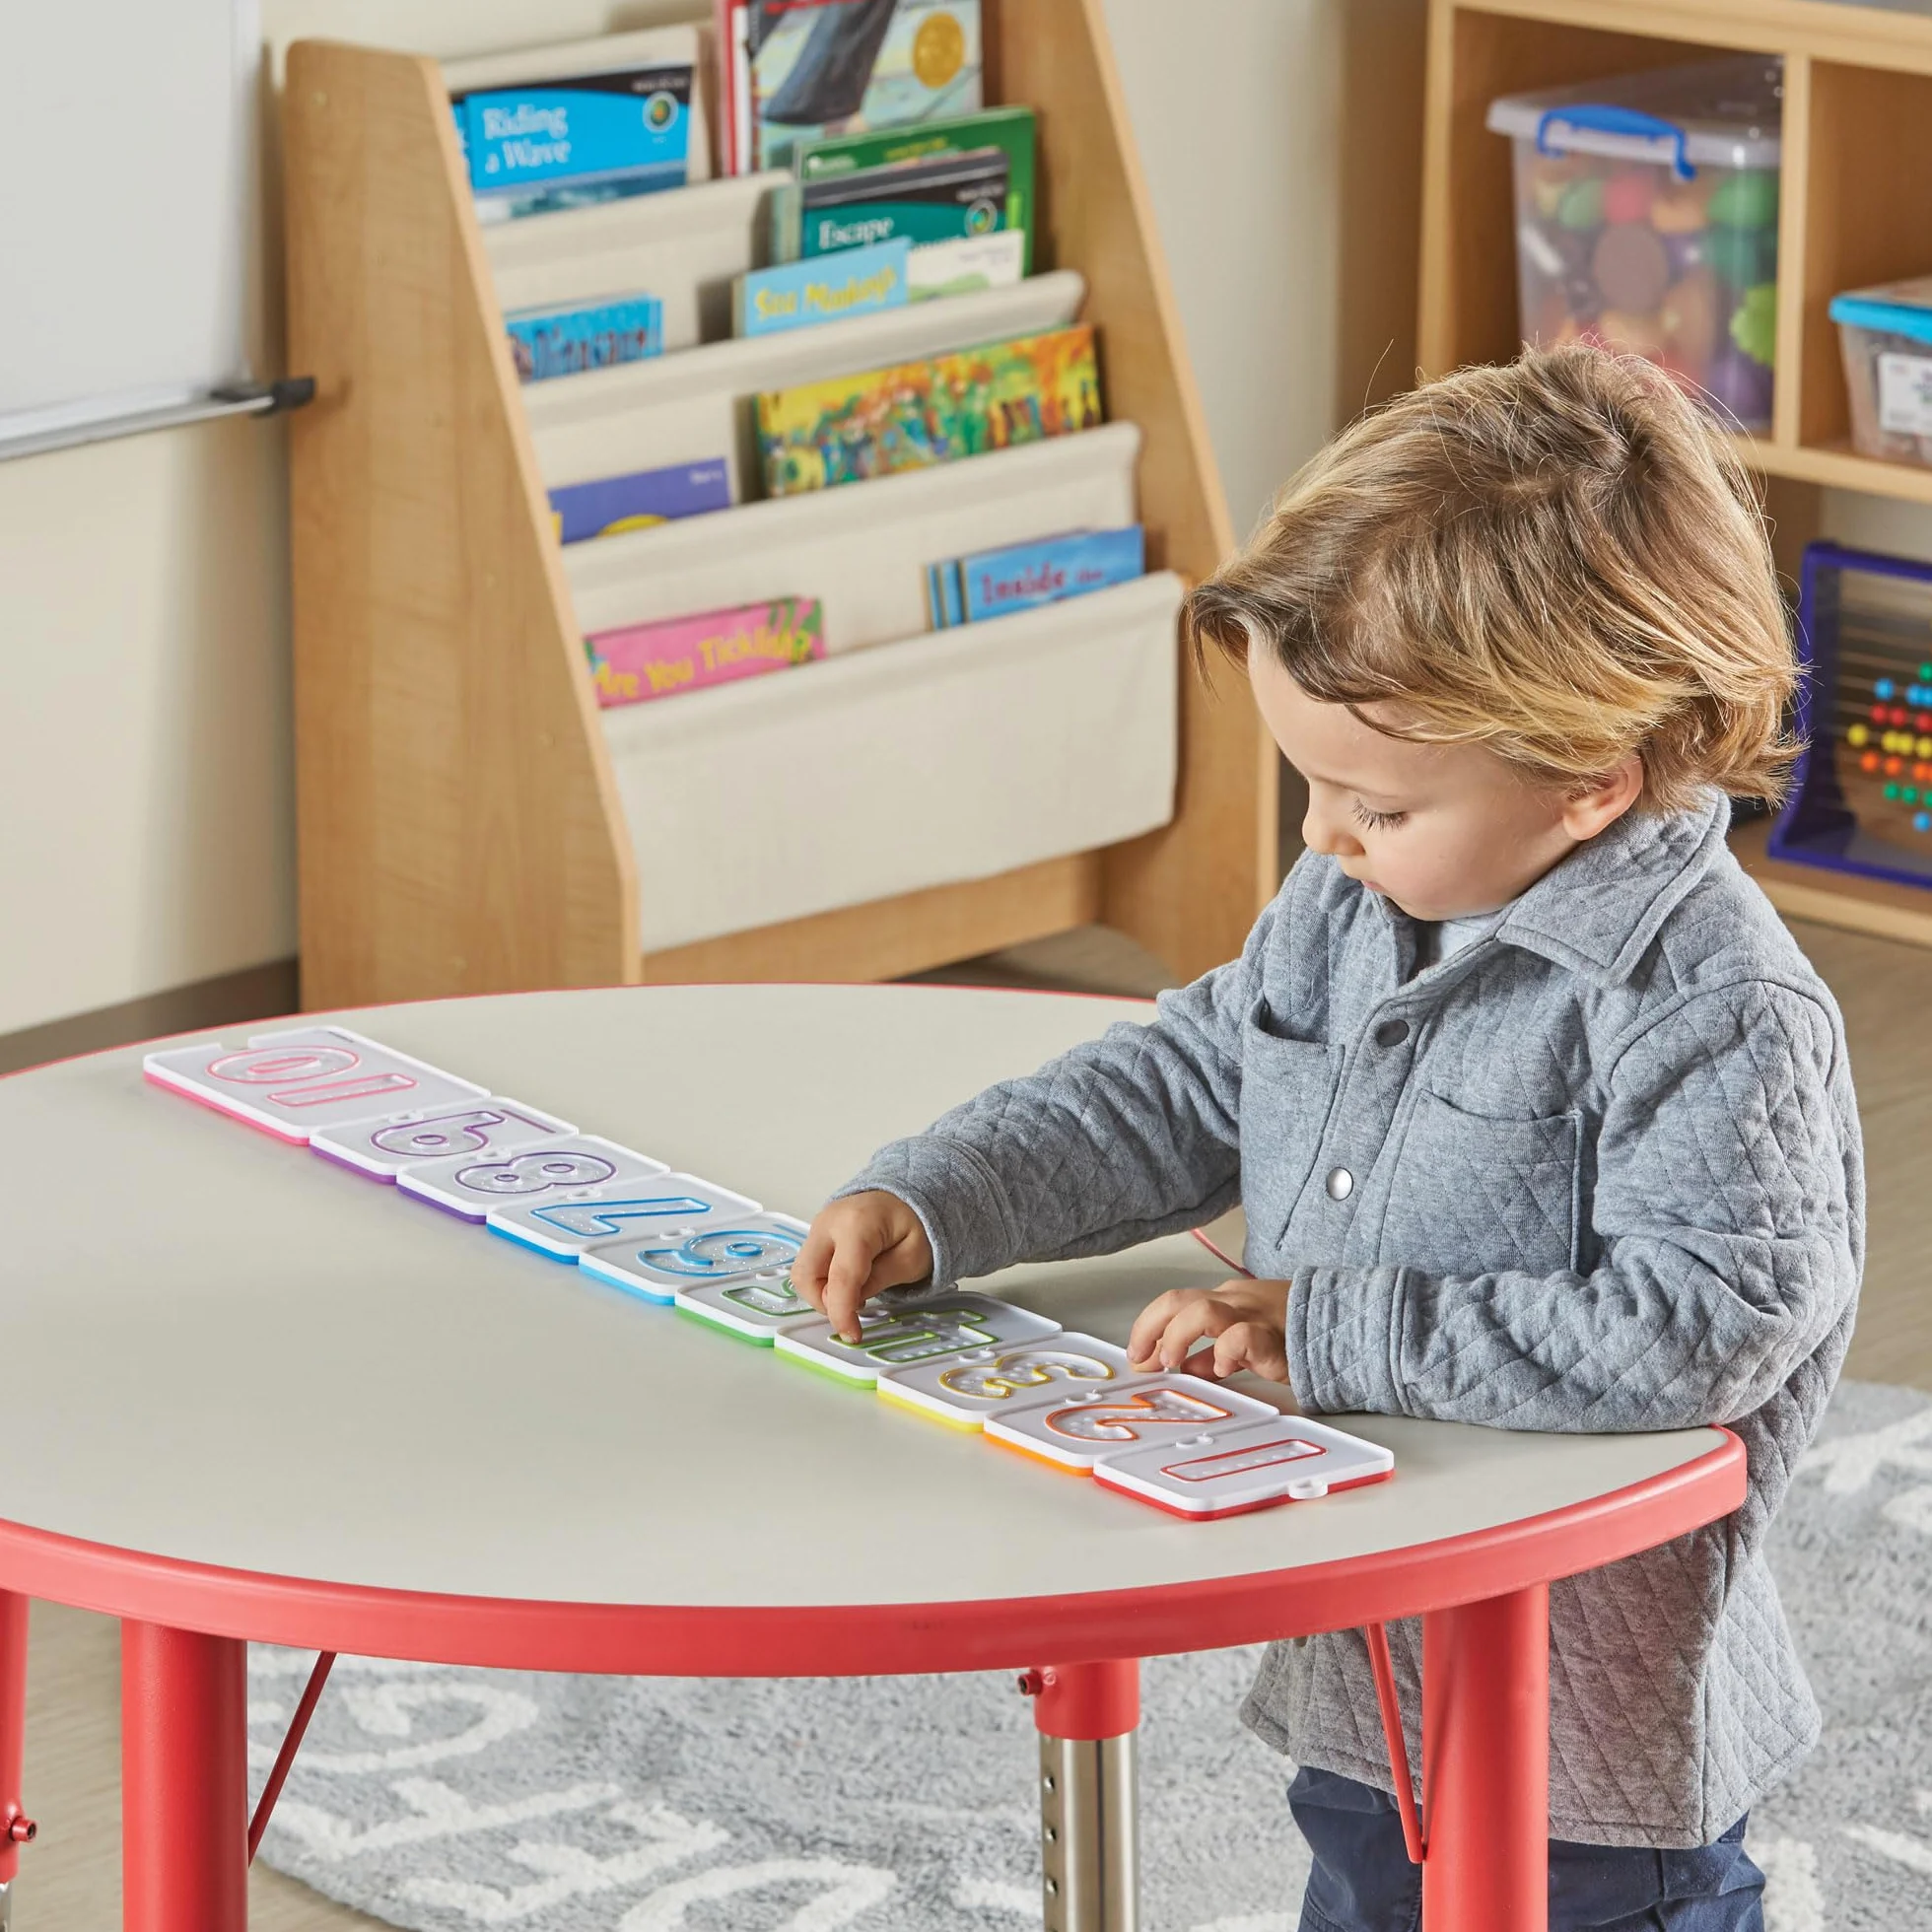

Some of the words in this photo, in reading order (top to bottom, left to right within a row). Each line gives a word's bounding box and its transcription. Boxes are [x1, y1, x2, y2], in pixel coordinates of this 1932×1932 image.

[502, 138, 572, 170] Wave
[818, 216, 894, 249] Escape
[981, 561, 1066, 606] Inside
[644, 658, 694, 693] You
[454, 1151, 617, 1194] 8
[530, 1197, 713, 1236] 7
[939, 1351, 1115, 1399] 3
[1045, 1388, 1232, 1441] 2
